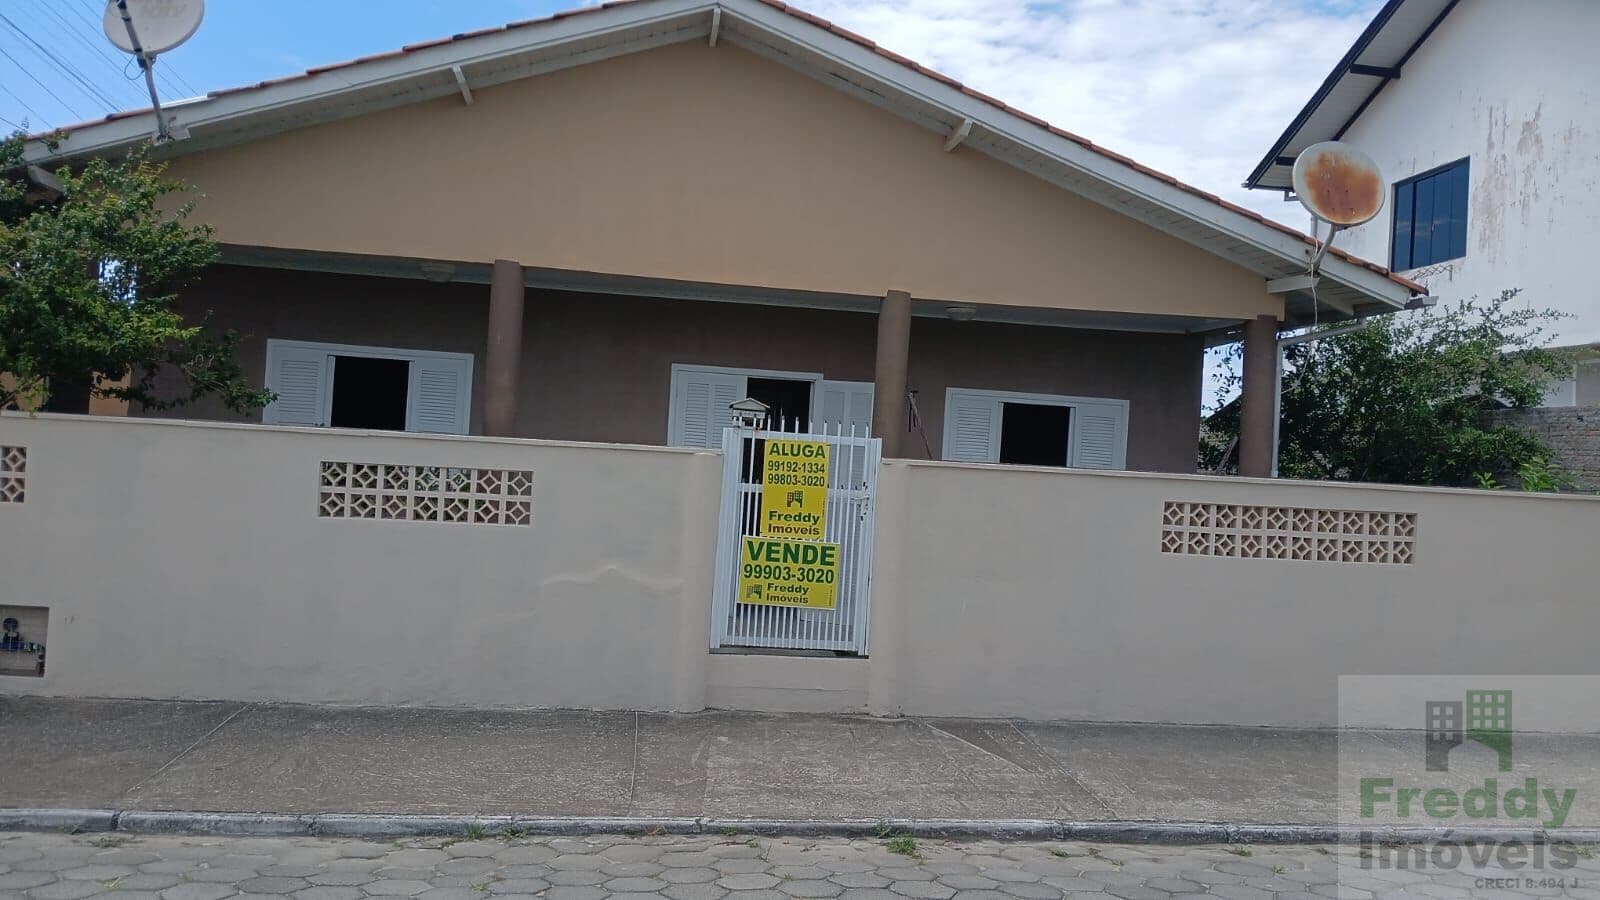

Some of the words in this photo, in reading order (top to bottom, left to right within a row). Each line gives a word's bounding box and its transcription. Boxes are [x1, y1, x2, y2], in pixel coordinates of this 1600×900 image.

[769, 443, 826, 459] ALUGA
[768, 460, 826, 474] 99192-1334
[768, 474, 825, 487] 99803-3020
[768, 510, 820, 525] Freddy
[768, 523, 820, 535] Imóveis
[747, 540, 836, 566] VENDE
[743, 564, 834, 584] 99903-3020
[767, 582, 809, 595] Freddy
[766, 592, 809, 604] Imóveis
